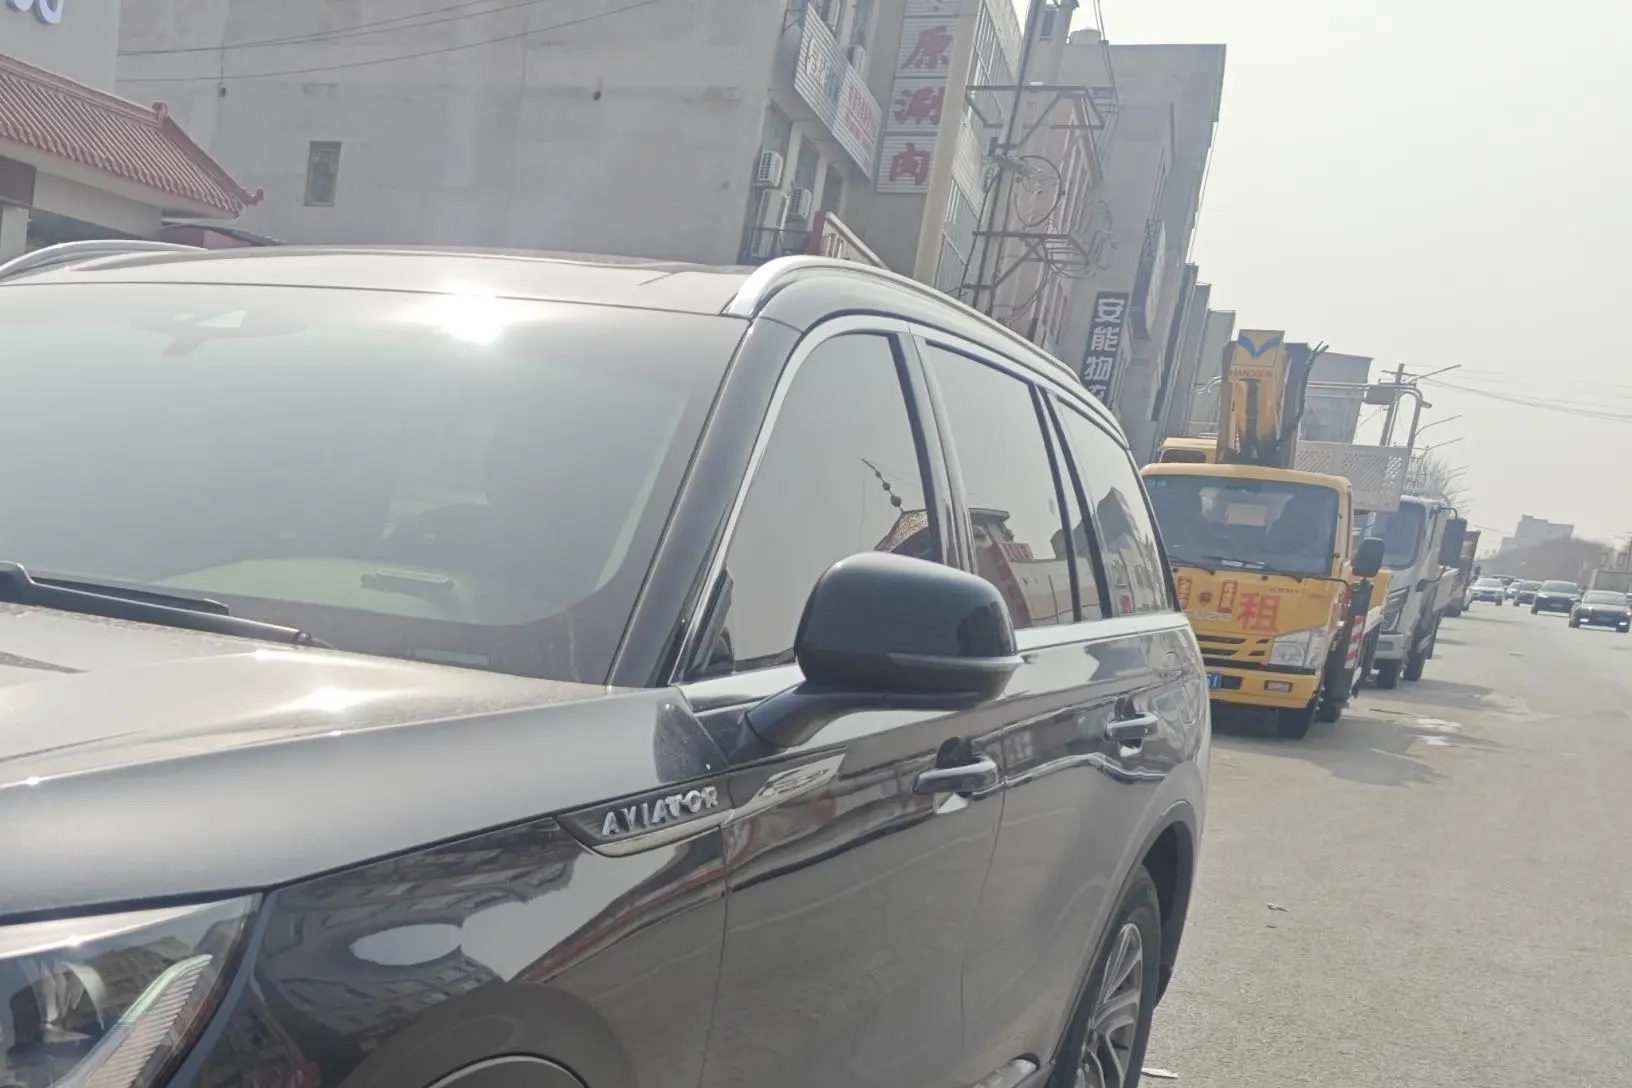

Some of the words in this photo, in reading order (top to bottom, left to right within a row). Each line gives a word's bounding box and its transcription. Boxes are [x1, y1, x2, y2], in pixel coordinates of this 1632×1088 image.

[889, 0, 954, 186] 原涮肉
[1236, 592, 1282, 632] 租
[601, 786, 718, 836] AVIATOR
